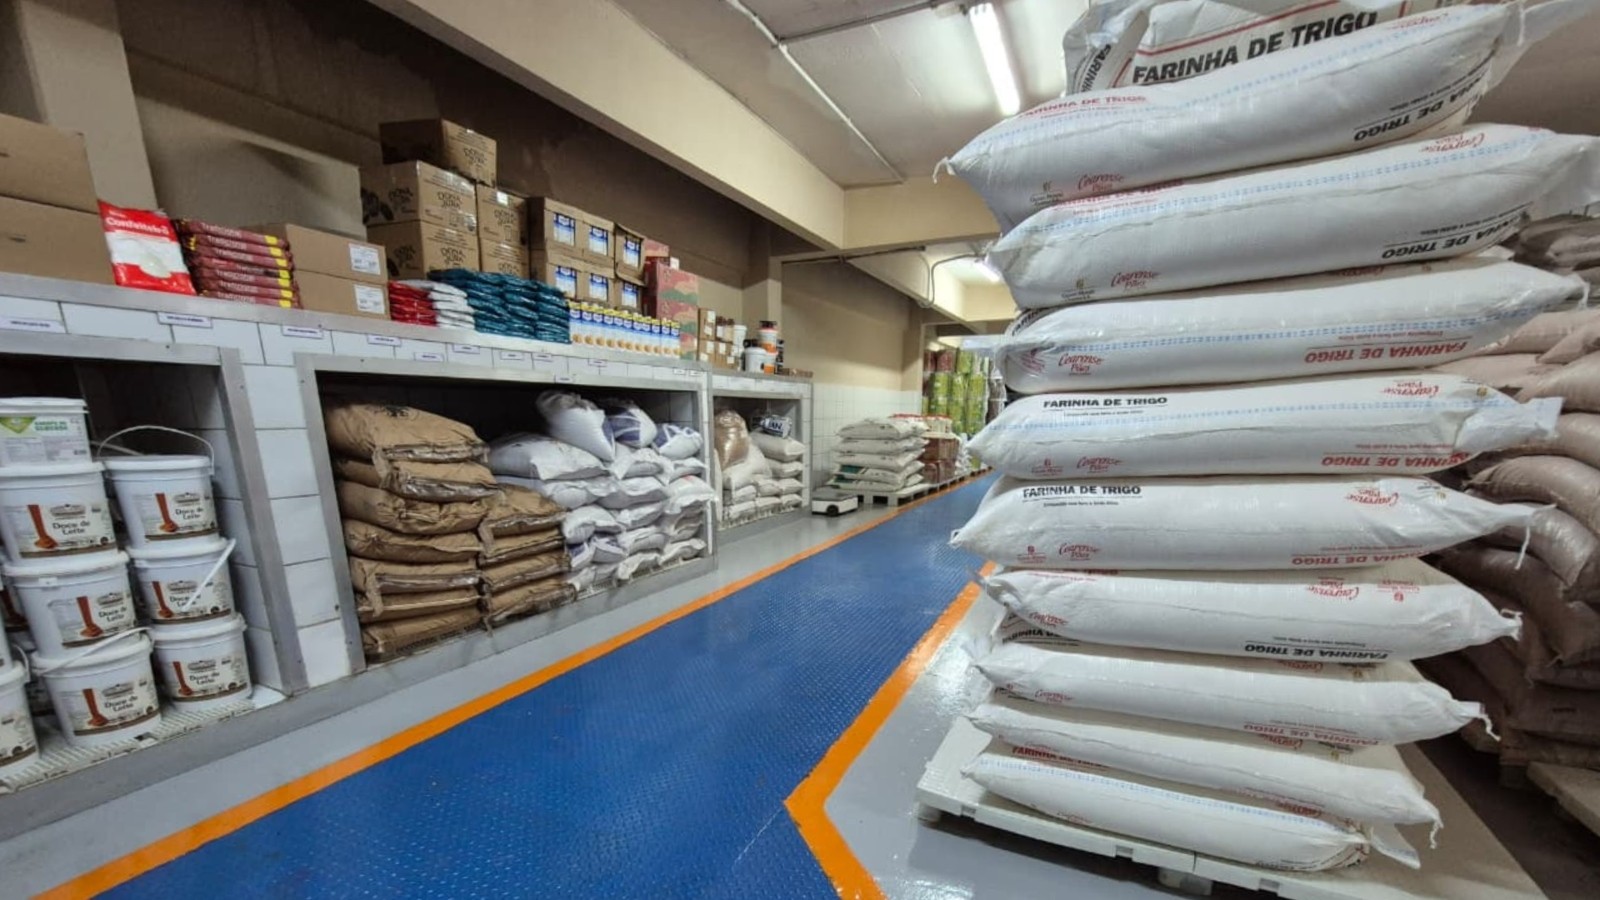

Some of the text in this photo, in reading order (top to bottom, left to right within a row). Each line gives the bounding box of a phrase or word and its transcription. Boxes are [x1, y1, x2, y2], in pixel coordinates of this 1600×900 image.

[1132, 11, 1379, 84] FARINHA DE TRIGO
[1080, 43, 1112, 93] FARINH
[1354, 113, 1411, 142] TRIGO
[1417, 100, 1444, 120] DE
[1382, 235, 1471, 259] TRIGO DE
[1110, 270, 1160, 287] Cearense
[1058, 353, 1104, 367] Cearense
[1304, 341, 1468, 364] TRIGO DE FARINHA
[1043, 396, 1168, 409] FARINHA DE TRIGO
[1321, 455, 1373, 467] TRIGO
[1376, 455, 1399, 467] DE
[1023, 485, 1142, 498] FARINHA DE TRIGO
[1344, 491, 1399, 507] Cearense
[1291, 555, 1339, 566] TRIGO
[1344, 555, 1367, 565] DE
[1305, 586, 1360, 600] Cearense
[1244, 644, 1388, 661] TRIGO DE FARINHA
[1290, 729, 1311, 739] DE
